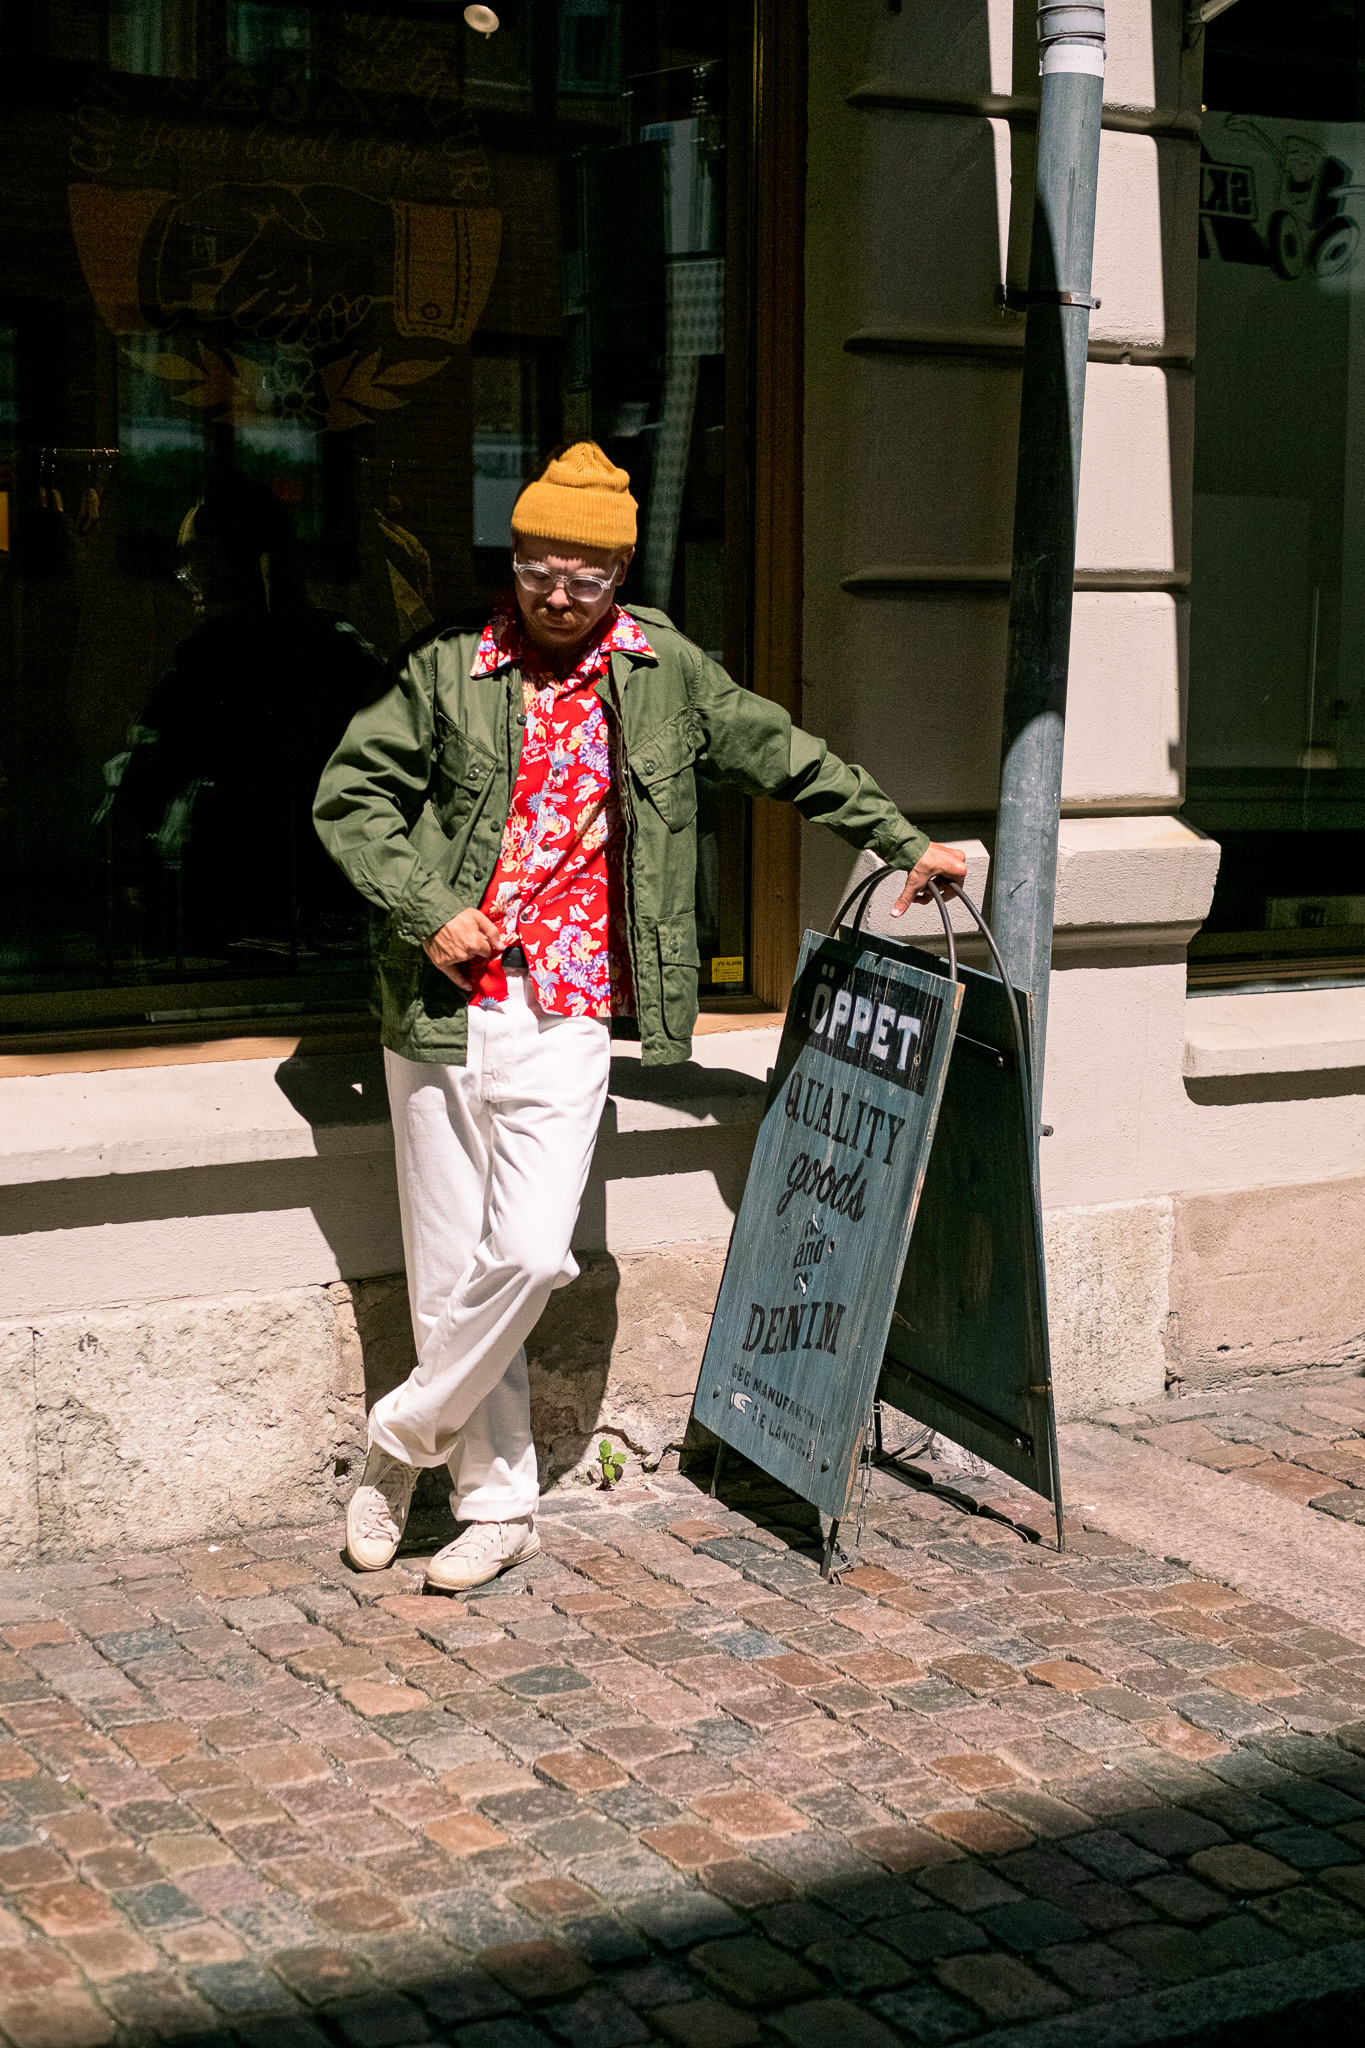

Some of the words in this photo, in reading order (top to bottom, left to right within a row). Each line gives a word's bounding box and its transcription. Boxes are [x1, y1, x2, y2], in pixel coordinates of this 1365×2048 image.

[809, 963, 921, 1070] ÖPPET
[785, 1071, 905, 1166] QUALITY
[776, 1152, 867, 1222] goods
[793, 1234, 827, 1268] and
[742, 1302, 846, 1355] DENIM
